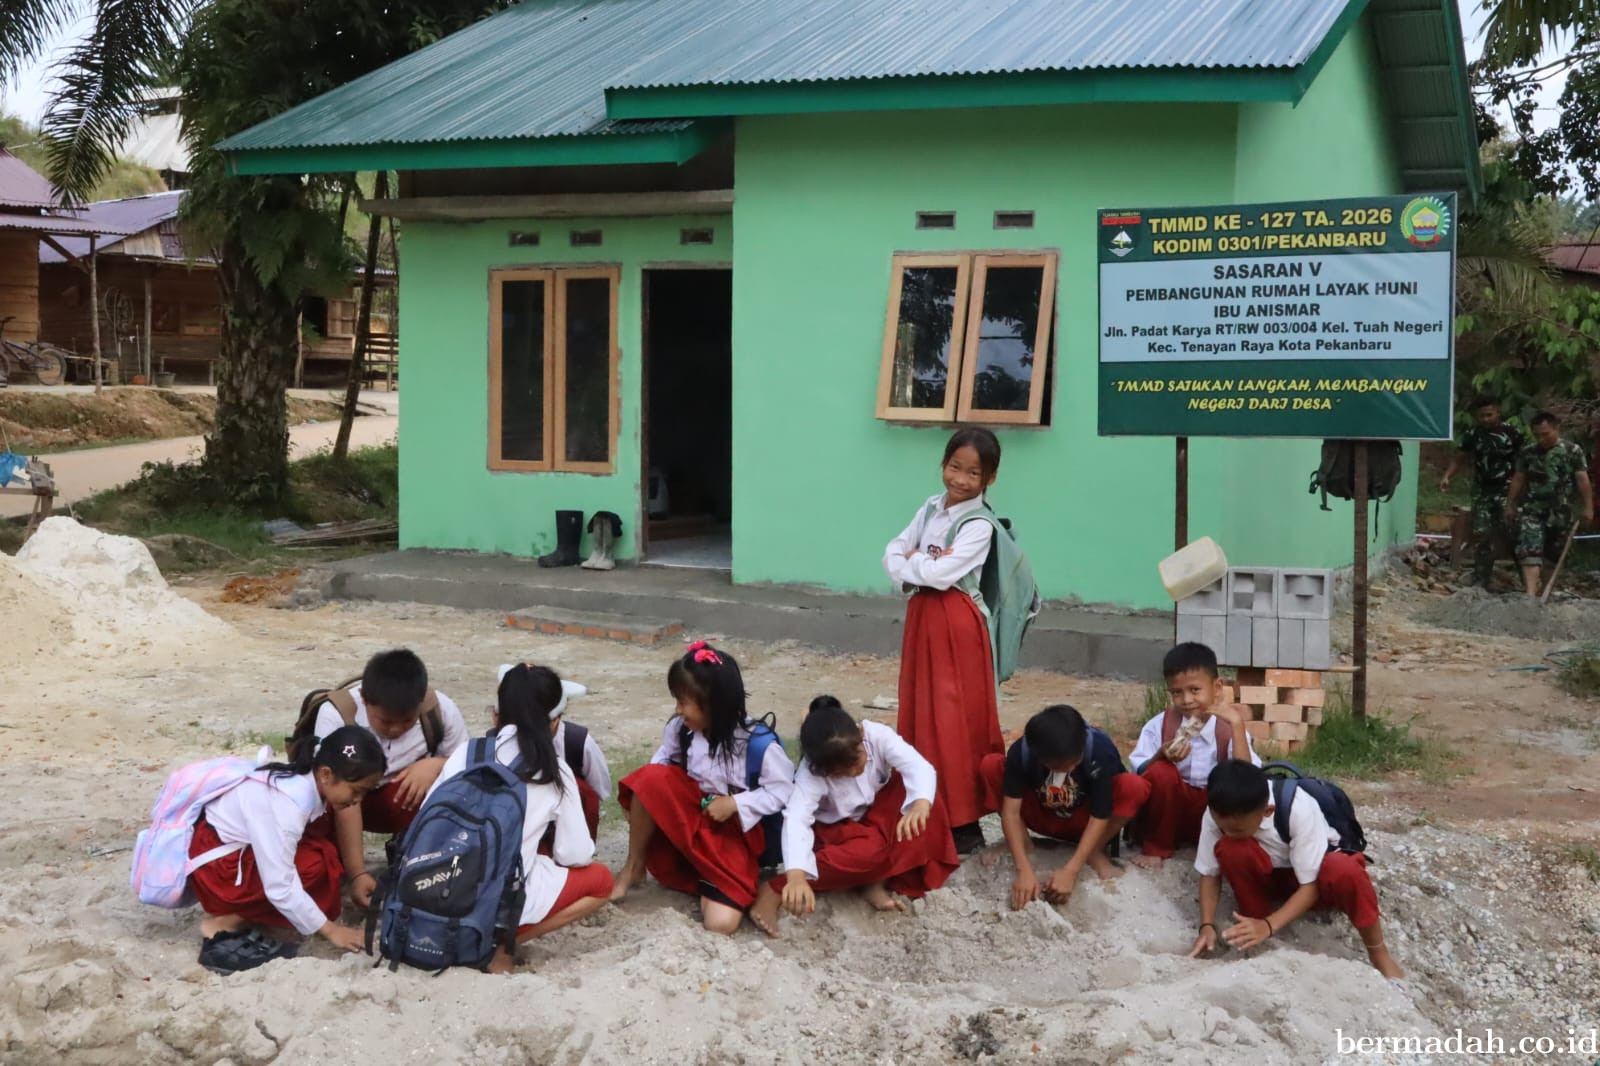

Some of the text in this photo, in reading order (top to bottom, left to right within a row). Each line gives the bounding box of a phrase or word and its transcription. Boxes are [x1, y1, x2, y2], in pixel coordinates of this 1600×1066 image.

[1148, 216, 1208, 234] TMMD
[1213, 214, 1241, 231] KE
[1260, 212, 1296, 229] 127
[1302, 210, 1335, 227] TA.
[1341, 208, 1393, 226] 2026
[1153, 231, 1387, 254] KODIM 0301/PEKANBARU
[1213, 261, 1322, 280] SASARAN V
[1126, 281, 1418, 302] PEMBANGUNAN RUMAH LAYAK HUNI
[1214, 303, 1321, 318] IBU ANISMAR
[1104, 320, 1443, 338] Jln. Padat Karya RT/RW 003/004 Kel. Tuah Negeri
[1148, 338, 1392, 355] Kec. Tenayan Raya Kota Pekanbaru
[1167, 379, 1234, 392] SATUKAN
[1237, 379, 1311, 394] LANGKAH,
[1314, 379, 1428, 394] MEMBANGUN
[1187, 398, 1245, 412] NEGERI
[1248, 398, 1288, 410] DARI
